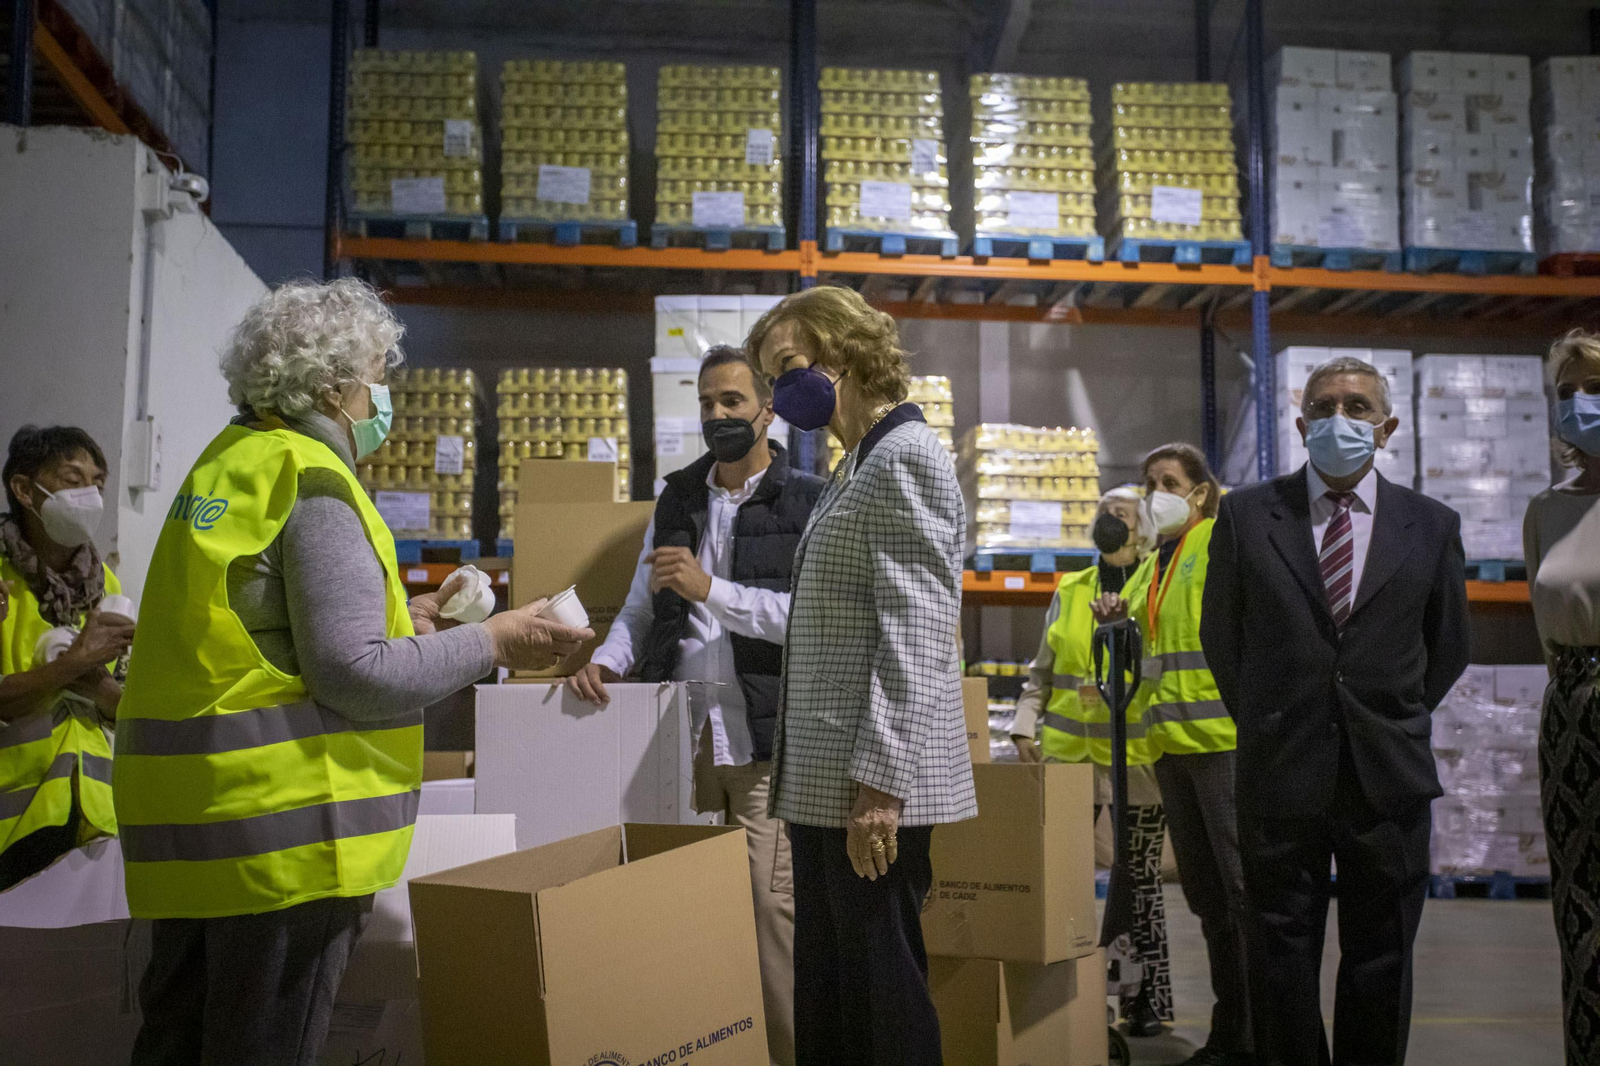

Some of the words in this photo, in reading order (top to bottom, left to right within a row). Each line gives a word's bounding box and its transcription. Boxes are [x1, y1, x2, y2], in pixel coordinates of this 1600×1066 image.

[939, 880, 968, 890] BANCO
[970, 882, 981, 890] DE
[983, 882, 1031, 893] ALIMENTOS
[939, 891, 951, 900] DE
[637, 1049, 677, 1066] ANCO
[679, 1041, 694, 1059] DE
[696, 1016, 753, 1052] ALIMENTOS
